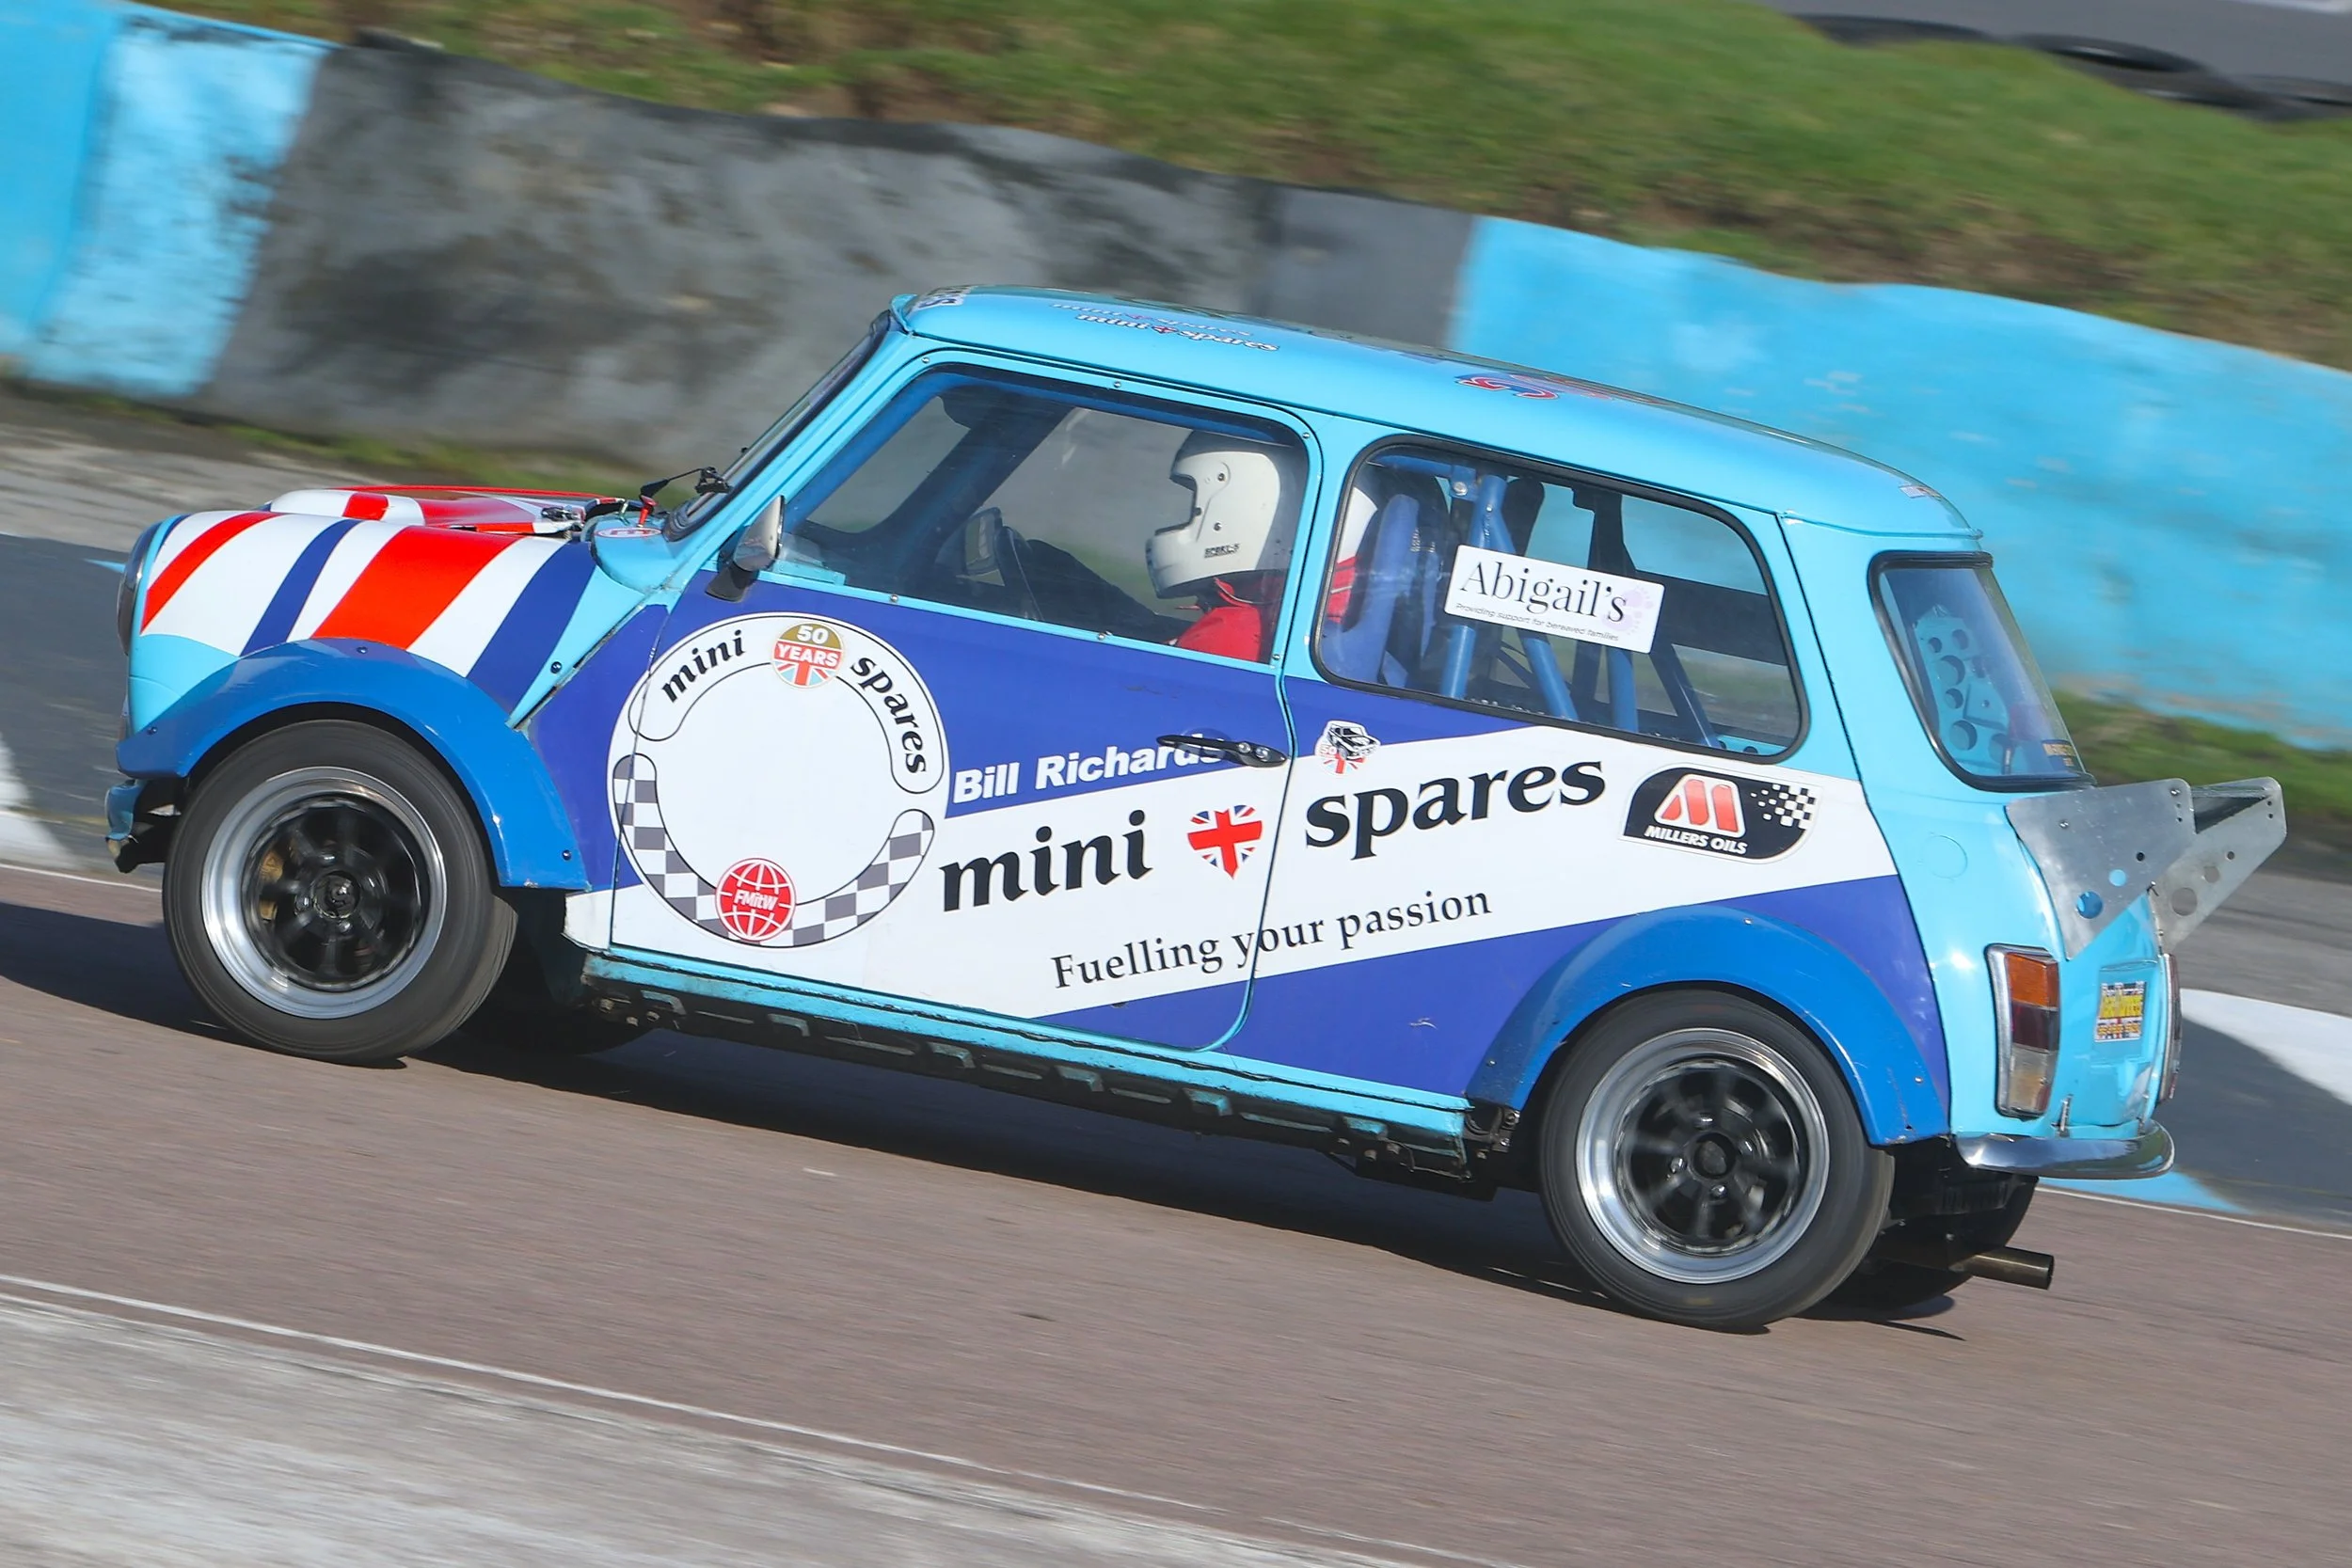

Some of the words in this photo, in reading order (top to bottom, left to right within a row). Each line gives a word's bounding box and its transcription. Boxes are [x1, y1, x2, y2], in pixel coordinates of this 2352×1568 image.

[1076, 313, 1150, 330] mini
[1177, 329, 1280, 352] spares
[796, 626, 827, 644] 50
[1455, 603, 1496, 618] Providing
[1497, 611, 1531, 625] support
[1533, 618, 1545, 626] for
[1546, 621, 1586, 635] bereaved
[1587, 627, 1620, 641] families
[777, 642, 838, 668] YEARS
[661, 629, 746, 703] mini
[850, 657, 927, 774] spares
[952, 761, 1020, 804] Bill
[940, 809, 1153, 911] mini
[1305, 761, 1606, 861] spares
[1644, 825, 1710, 847] MILLERS
[1710, 836, 1748, 855] OILS
[1050, 938, 1223, 989] Fuelling
[1232, 918, 1325, 969] your
[1336, 890, 1493, 951] passion
